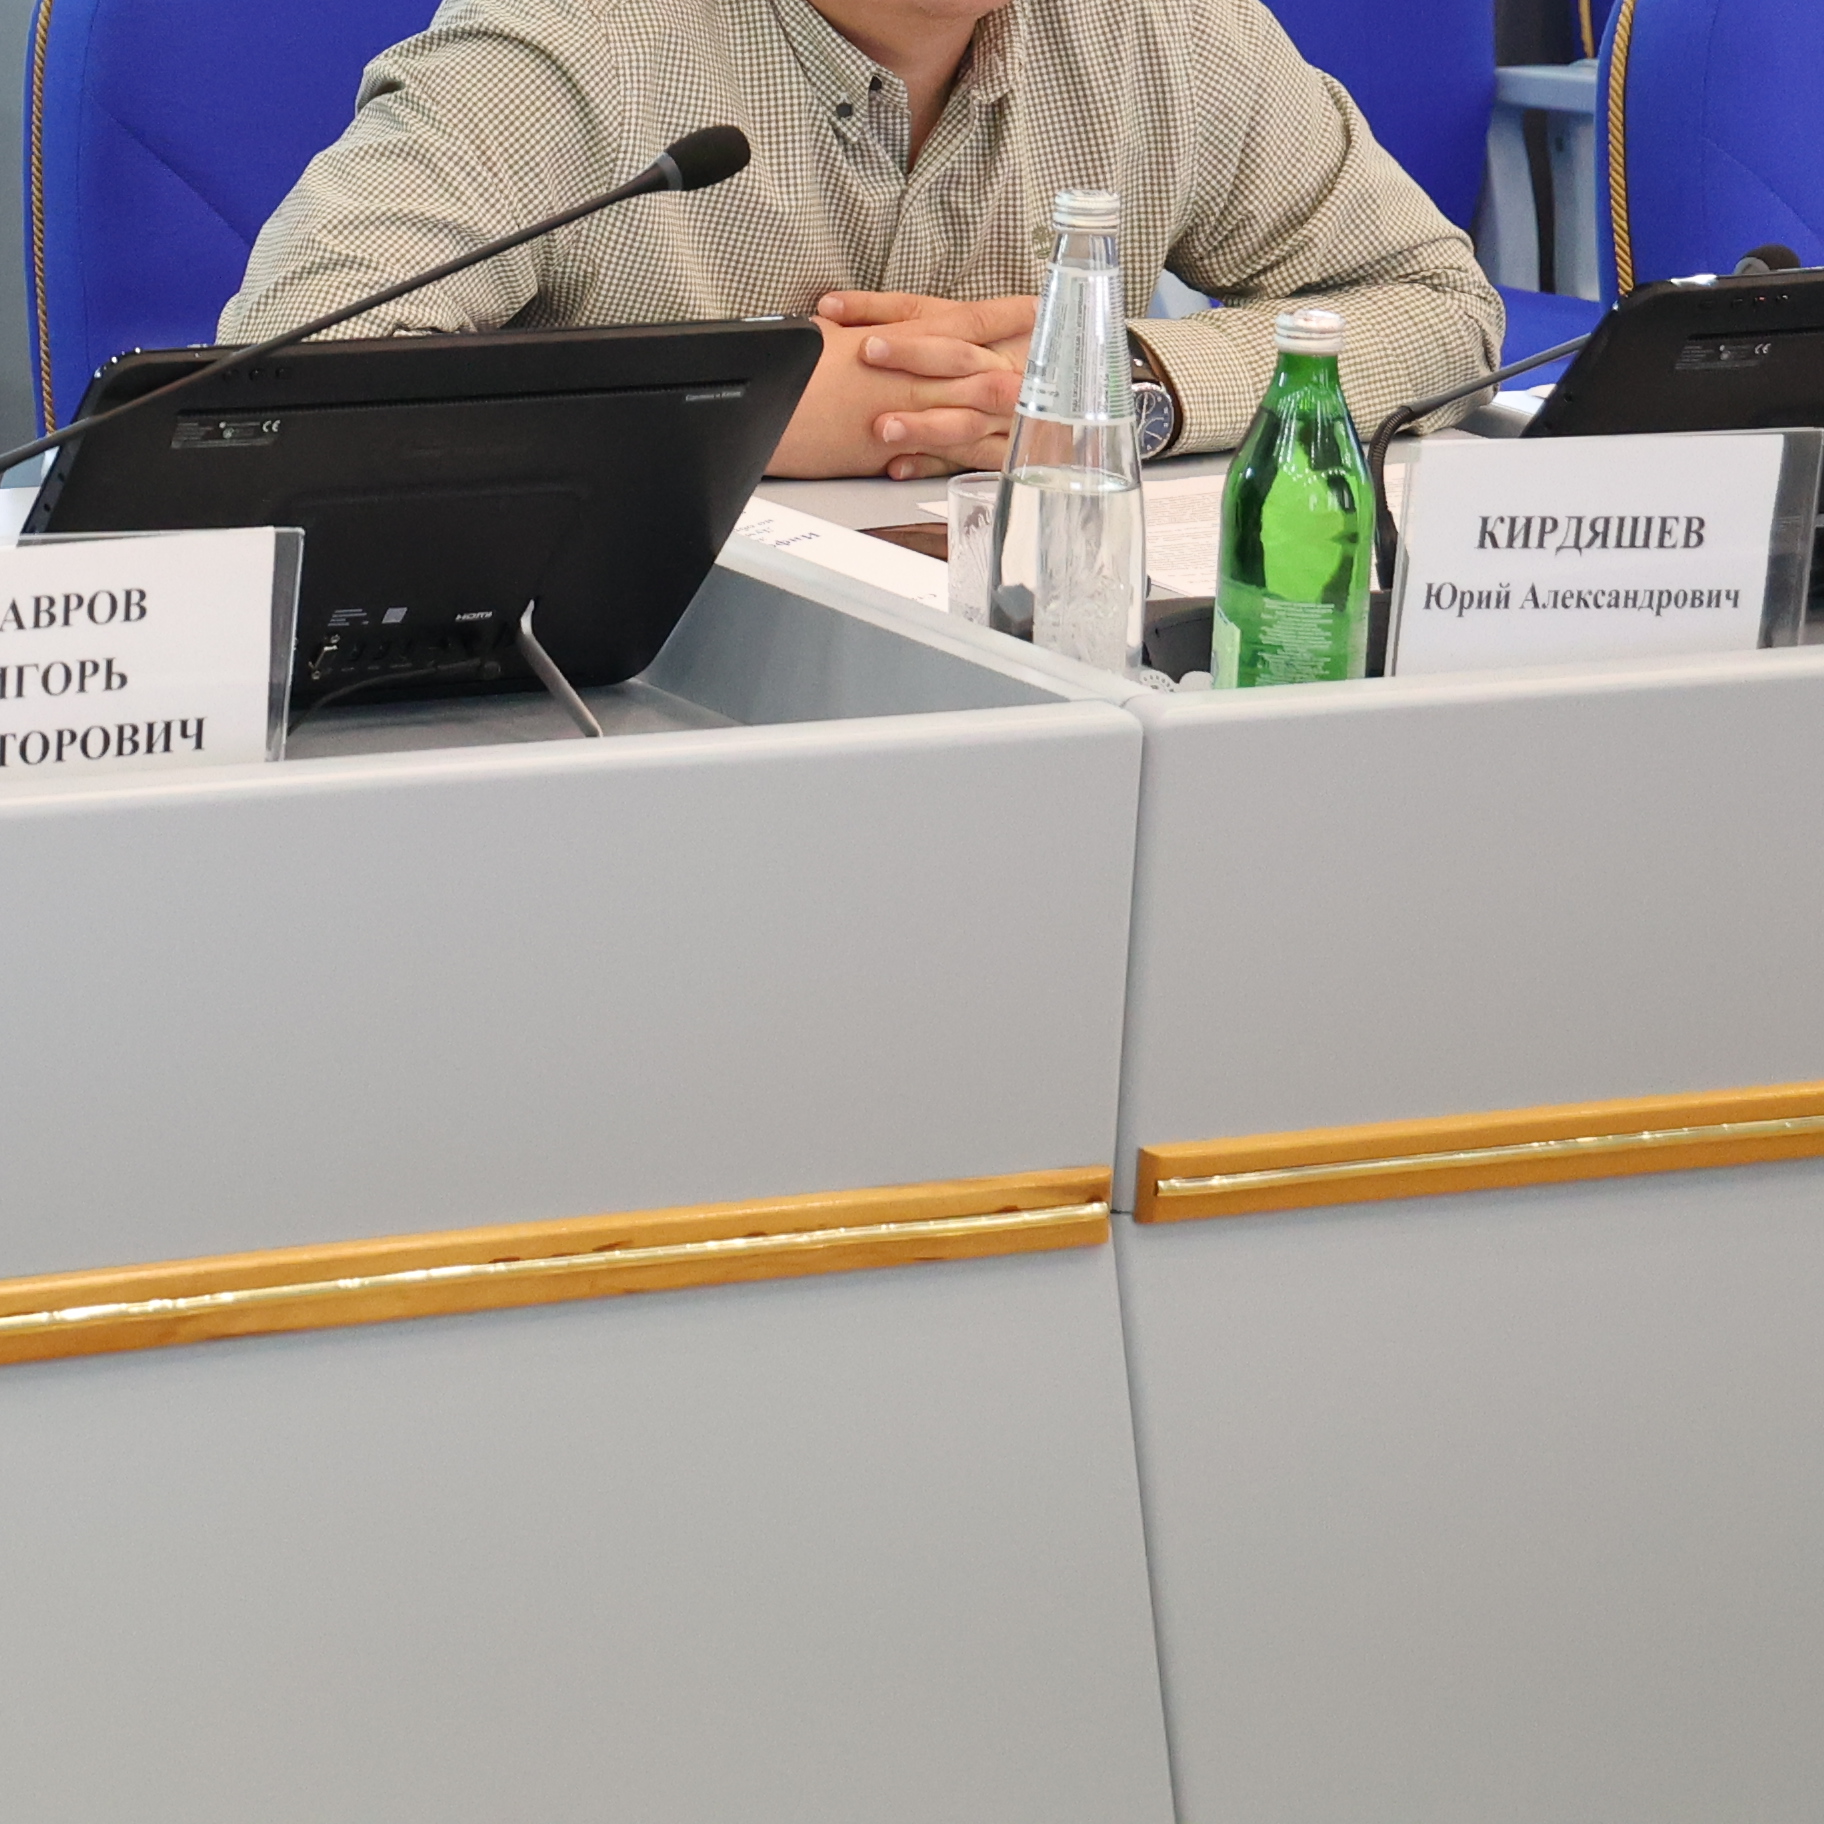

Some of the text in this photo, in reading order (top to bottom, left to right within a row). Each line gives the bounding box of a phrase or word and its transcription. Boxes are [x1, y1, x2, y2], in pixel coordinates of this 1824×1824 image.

[1475, 514, 1707, 556] КИРДЯШЕВ
[1422, 581, 1741, 618] Юрий Александрович
